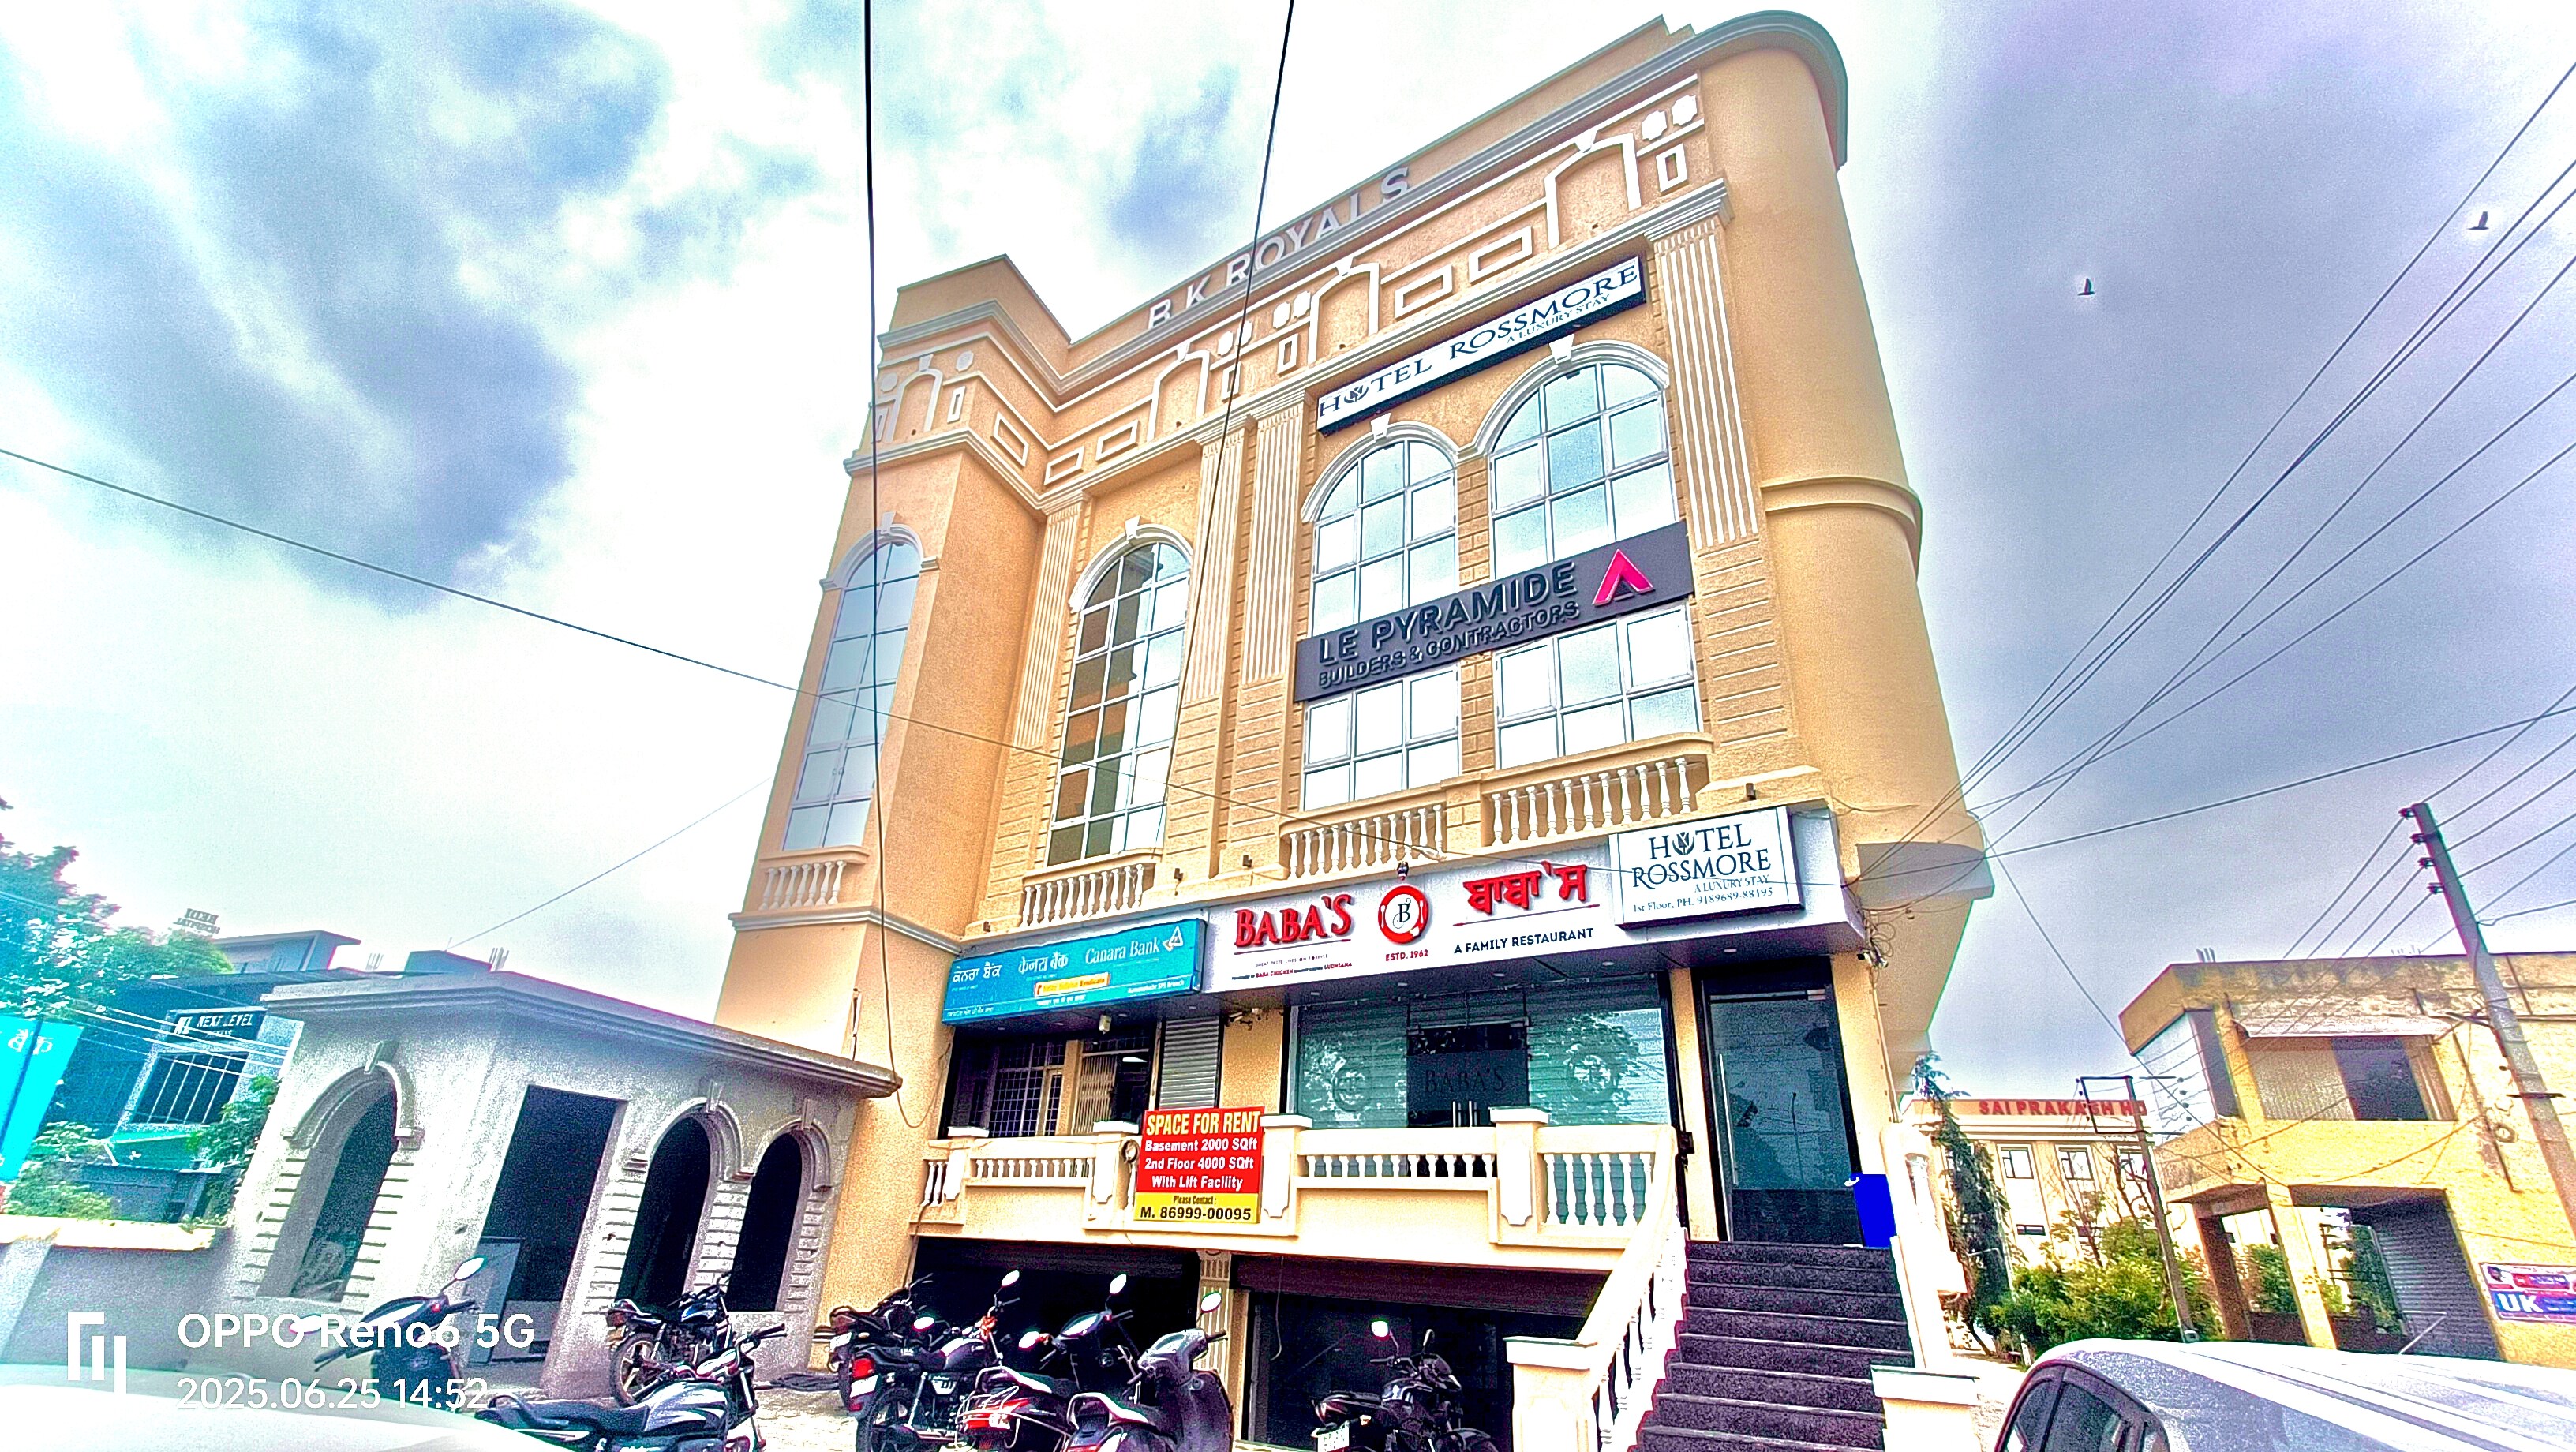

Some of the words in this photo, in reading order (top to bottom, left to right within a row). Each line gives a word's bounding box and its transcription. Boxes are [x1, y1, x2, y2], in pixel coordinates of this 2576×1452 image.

[1518, 312, 1573, 340] LUXURY
[1576, 294, 1612, 315] STAY
[1318, 357, 1432, 418] HOTEL
[1449, 264, 1638, 361] ROSSMORE
[1319, 629, 1360, 668] LE
[1372, 561, 1578, 650] PYRAMIDE
[1318, 652, 1407, 690] BUILDERS
[1409, 646, 1423, 664] &
[1425, 601, 1580, 660] CONTRACTORS
[1649, 823, 1752, 860] HOTEL
[1632, 848, 1772, 889] ROSSMORE
[1694, 884, 1702, 893] A
[1703, 878, 1744, 893] LUXURY
[1745, 874, 1769, 886] STAY
[1677, 897, 1694, 908] PH.
[1234, 893, 1352, 948] BABA'S
[1085, 946, 1126, 964] Canara
[1129, 937, 1160, 957] Bank
[1454, 945, 1462, 954] A
[1466, 937, 1508, 952] FAMILY
[1511, 927, 1594, 947] RESTAURANT
[1385, 952, 1409, 962] ESTD.
[1410, 949, 1428, 959] 1962
[1979, 1100, 2012, 1115] SAI
[2016, 1100, 2115, 1115] PRAKASH
[1146, 1113, 1191, 1136] SPACE
[1193, 1113, 1219, 1135] FOR
[1222, 1110, 1261, 1134] RENT
[1145, 1140, 1199, 1152] Basement
[1200, 1138, 1229, 1151] 2000
[1232, 1136, 1258, 1151] SQft
[1144, 1158, 1164, 1169] 2nd
[1166, 1157, 1195, 1169] Floor
[1197, 1157, 1225, 1169] 4000
[1228, 1156, 1254, 1169] SQft
[1151, 1176, 1176, 1188] With
[1178, 1176, 1198, 1188] Lift
[1200, 1175, 1243, 1192] Facility
[1173, 1195, 1191, 1205] Please
[1140, 1206, 1155, 1218] M.
[1159, 1206, 1252, 1221] 86999-00095
